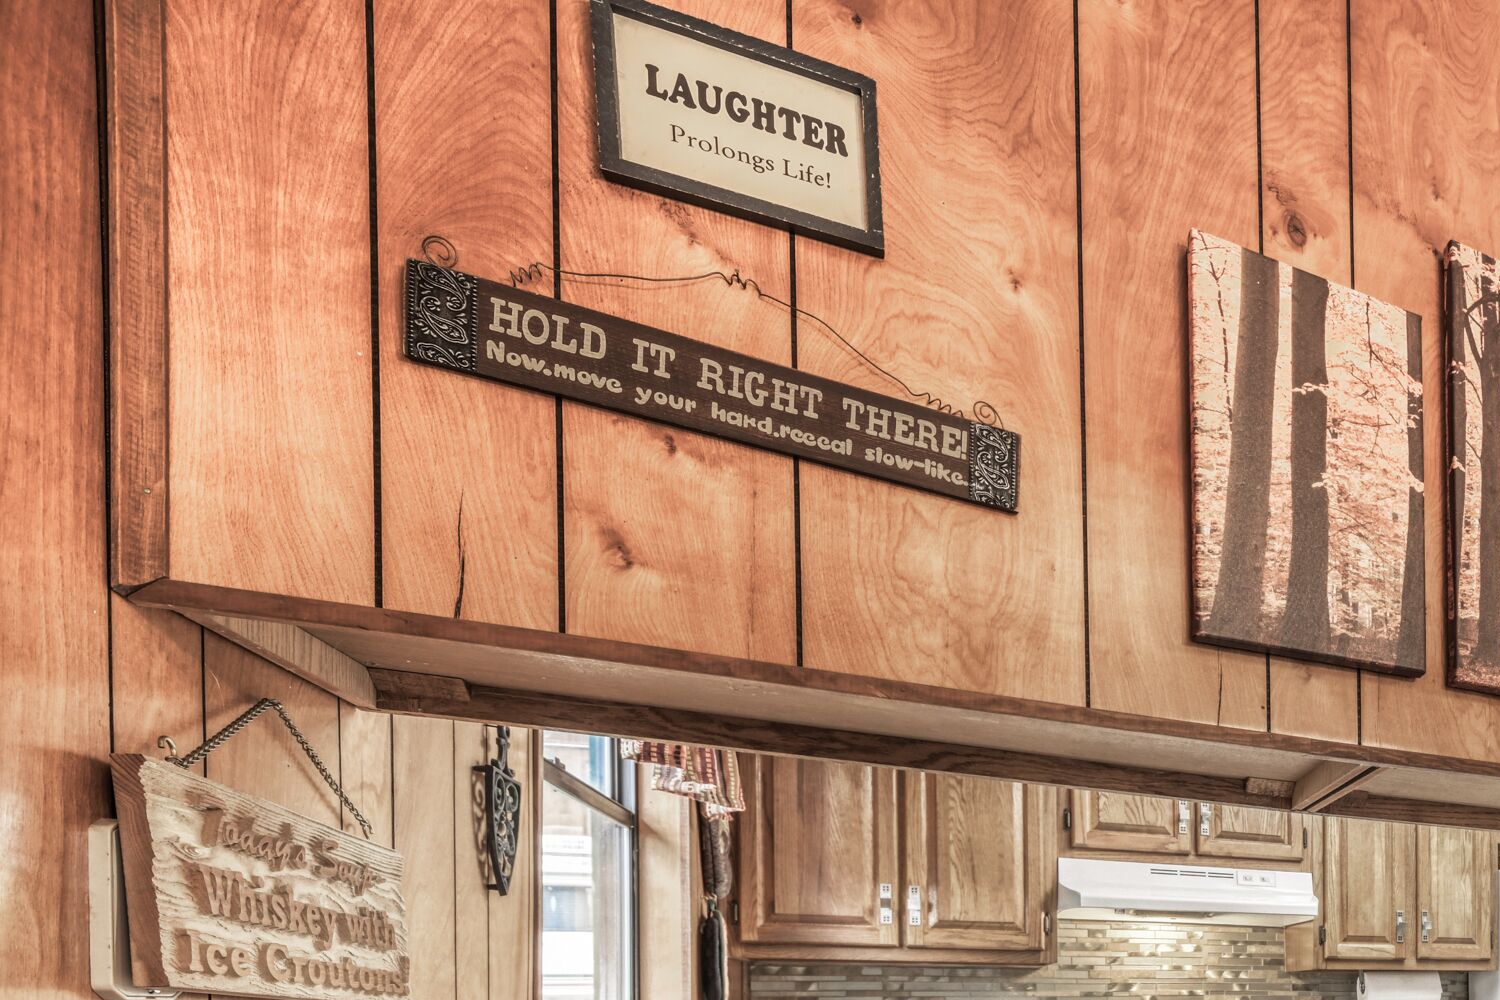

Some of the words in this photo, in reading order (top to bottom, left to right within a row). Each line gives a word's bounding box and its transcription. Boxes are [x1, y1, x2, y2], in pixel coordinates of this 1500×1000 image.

[645, 63, 848, 157] LAUGHTER
[670, 124, 775, 174] Prolongs
[782, 158, 832, 189] Life!
[489, 297, 606, 359] HOLD
[632, 338, 675, 378] IT
[697, 358, 823, 419] RIGHT
[842, 397, 967, 460] THERE!
[634, 387, 697, 413] your
[200, 866, 338, 950] Whiskey
[345, 907, 398, 950] with
[187, 930, 251, 977] Ice
[266, 943, 410, 996] Croutons!
